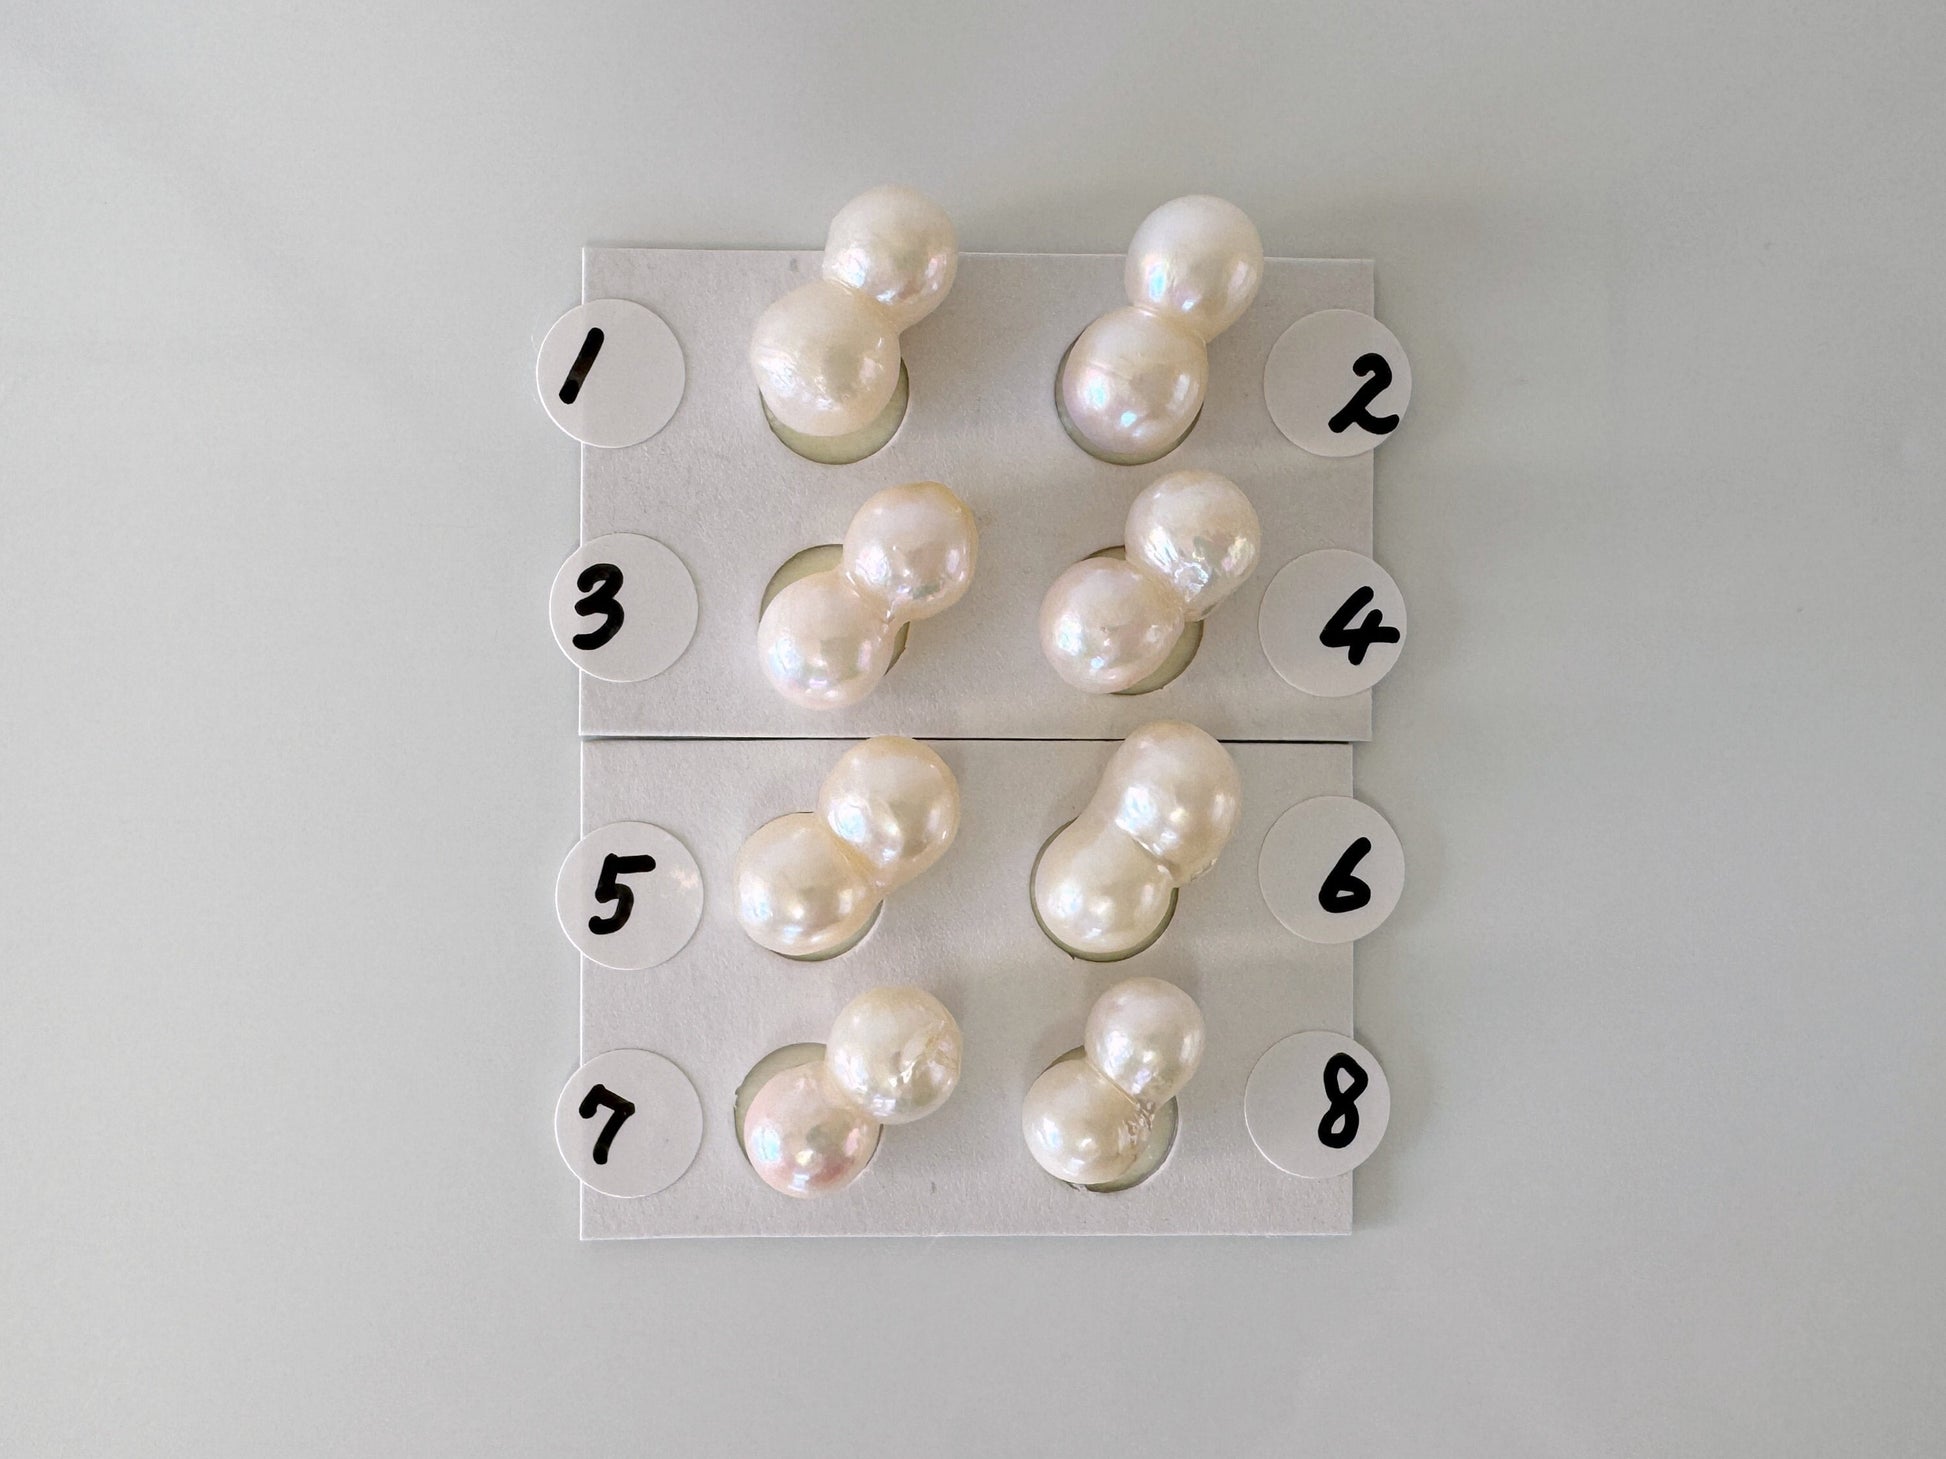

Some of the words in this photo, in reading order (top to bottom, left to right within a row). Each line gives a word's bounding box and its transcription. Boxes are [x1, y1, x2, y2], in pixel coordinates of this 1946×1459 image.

[559, 328, 604, 404] 1
[1328, 353, 1400, 435] 2
[573, 564, 624, 650] 3
[1319, 586, 1400, 665] 4
[589, 853, 656, 935] 5
[1319, 837, 1371, 913] 6
[579, 1084, 635, 1165] 7
[1318, 1053, 1368, 1148] 8
